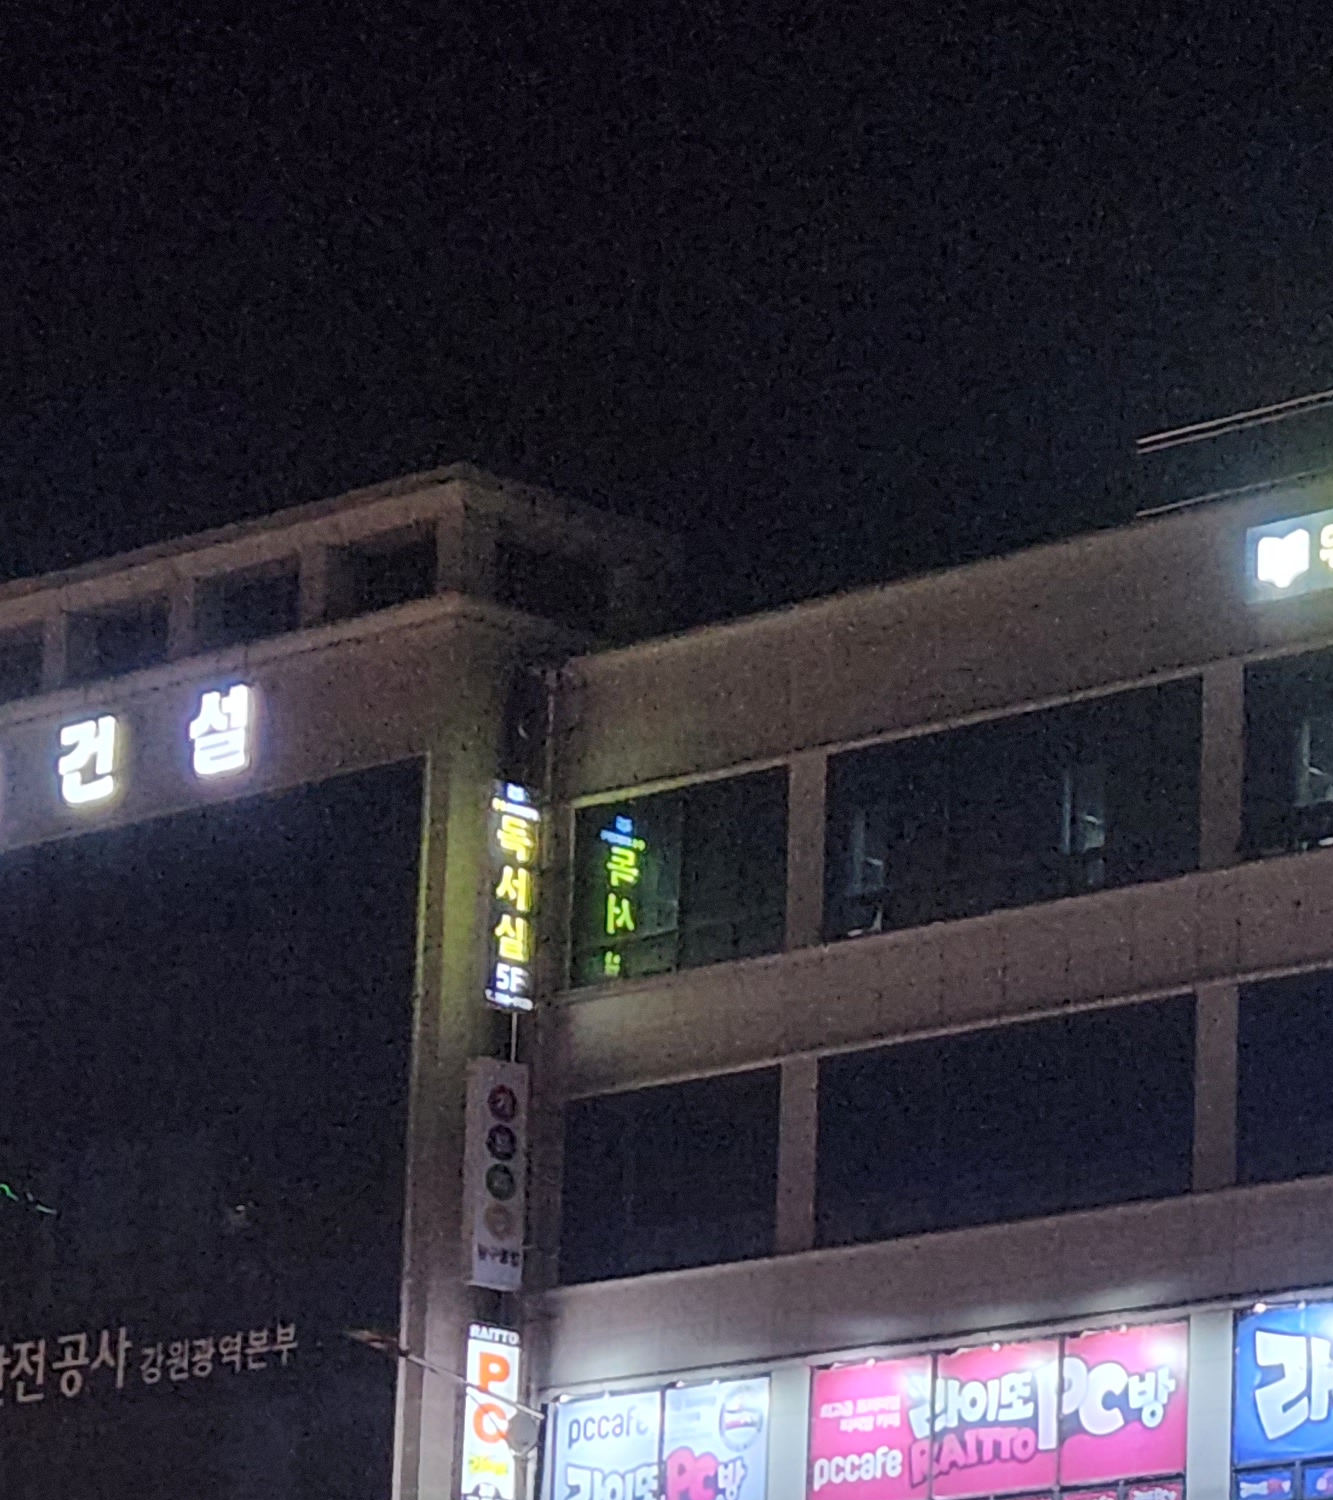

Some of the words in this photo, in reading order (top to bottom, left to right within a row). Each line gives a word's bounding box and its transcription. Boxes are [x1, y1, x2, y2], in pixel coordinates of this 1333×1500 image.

[495, 814, 533, 963] 독서실
[496, 963, 527, 992] 5F
[140, 1322, 298, 1384] 강원광역본부
[470, 1324, 520, 1345] RAITTO
[813, 1445, 903, 1491] pccafe
[910, 1426, 1036, 1488] RAITTO
